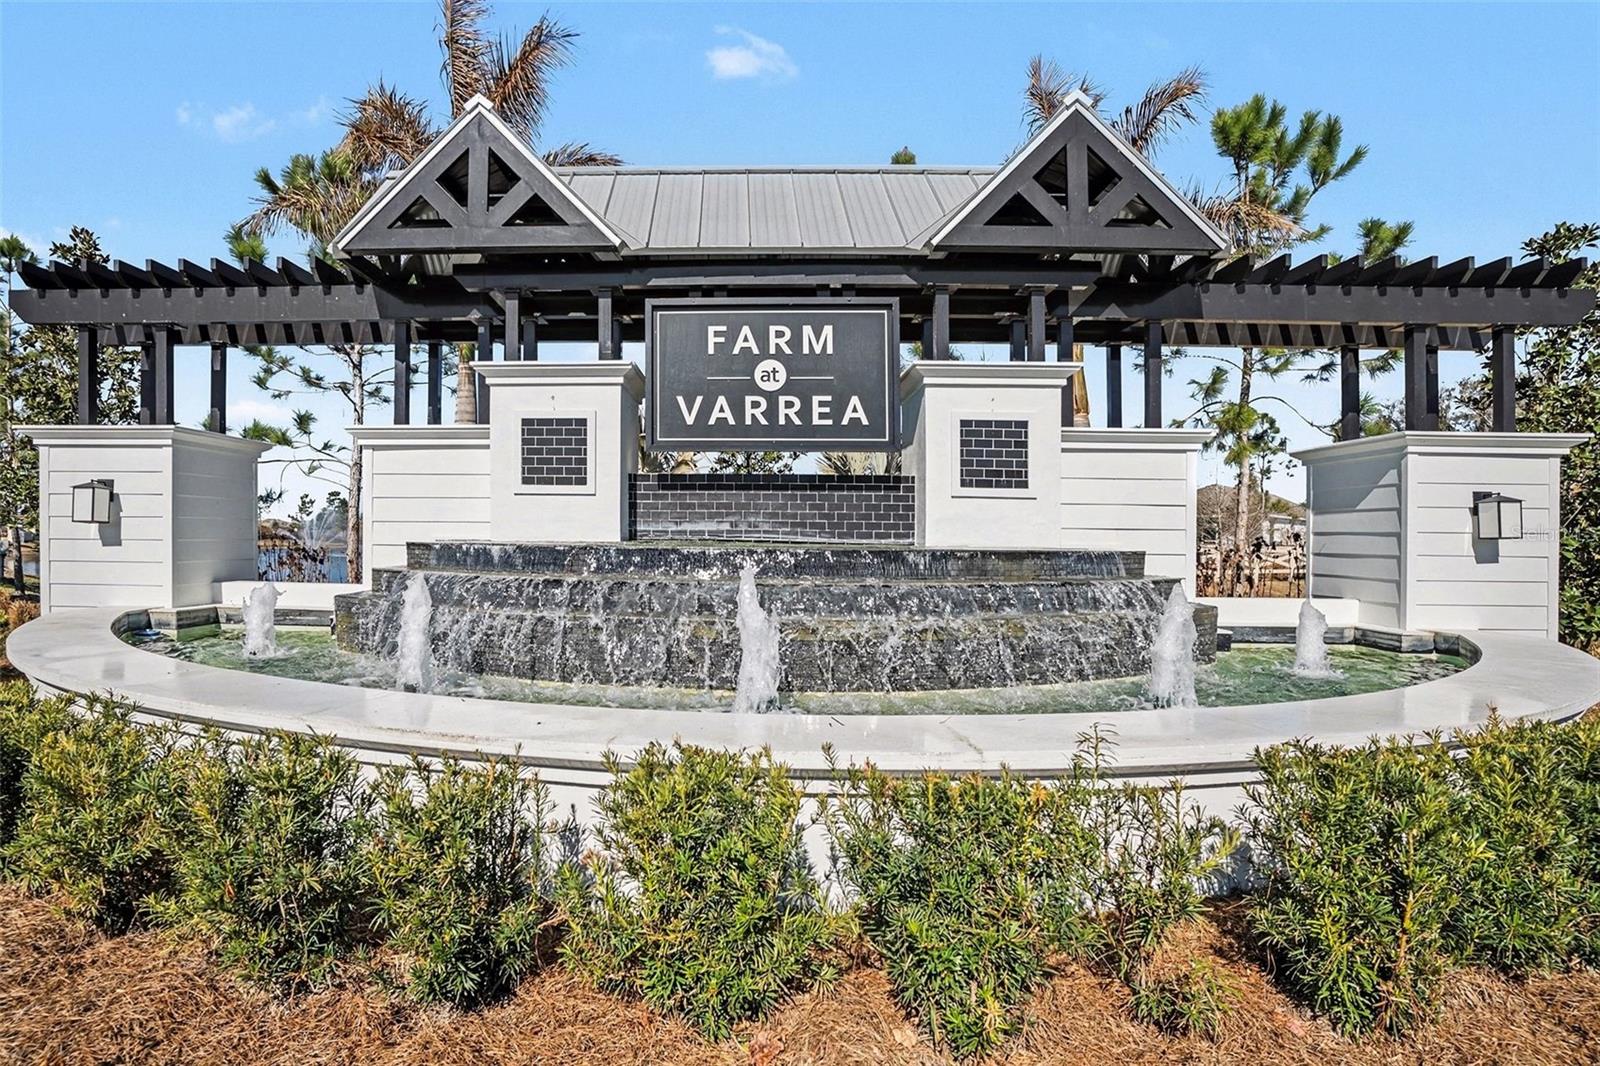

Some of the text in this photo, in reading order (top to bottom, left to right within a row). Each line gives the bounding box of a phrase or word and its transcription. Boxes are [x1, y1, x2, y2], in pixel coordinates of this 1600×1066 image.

[707, 325, 834, 355] FARM
[760, 366, 780, 383] at
[676, 395, 870, 426] VARREA
